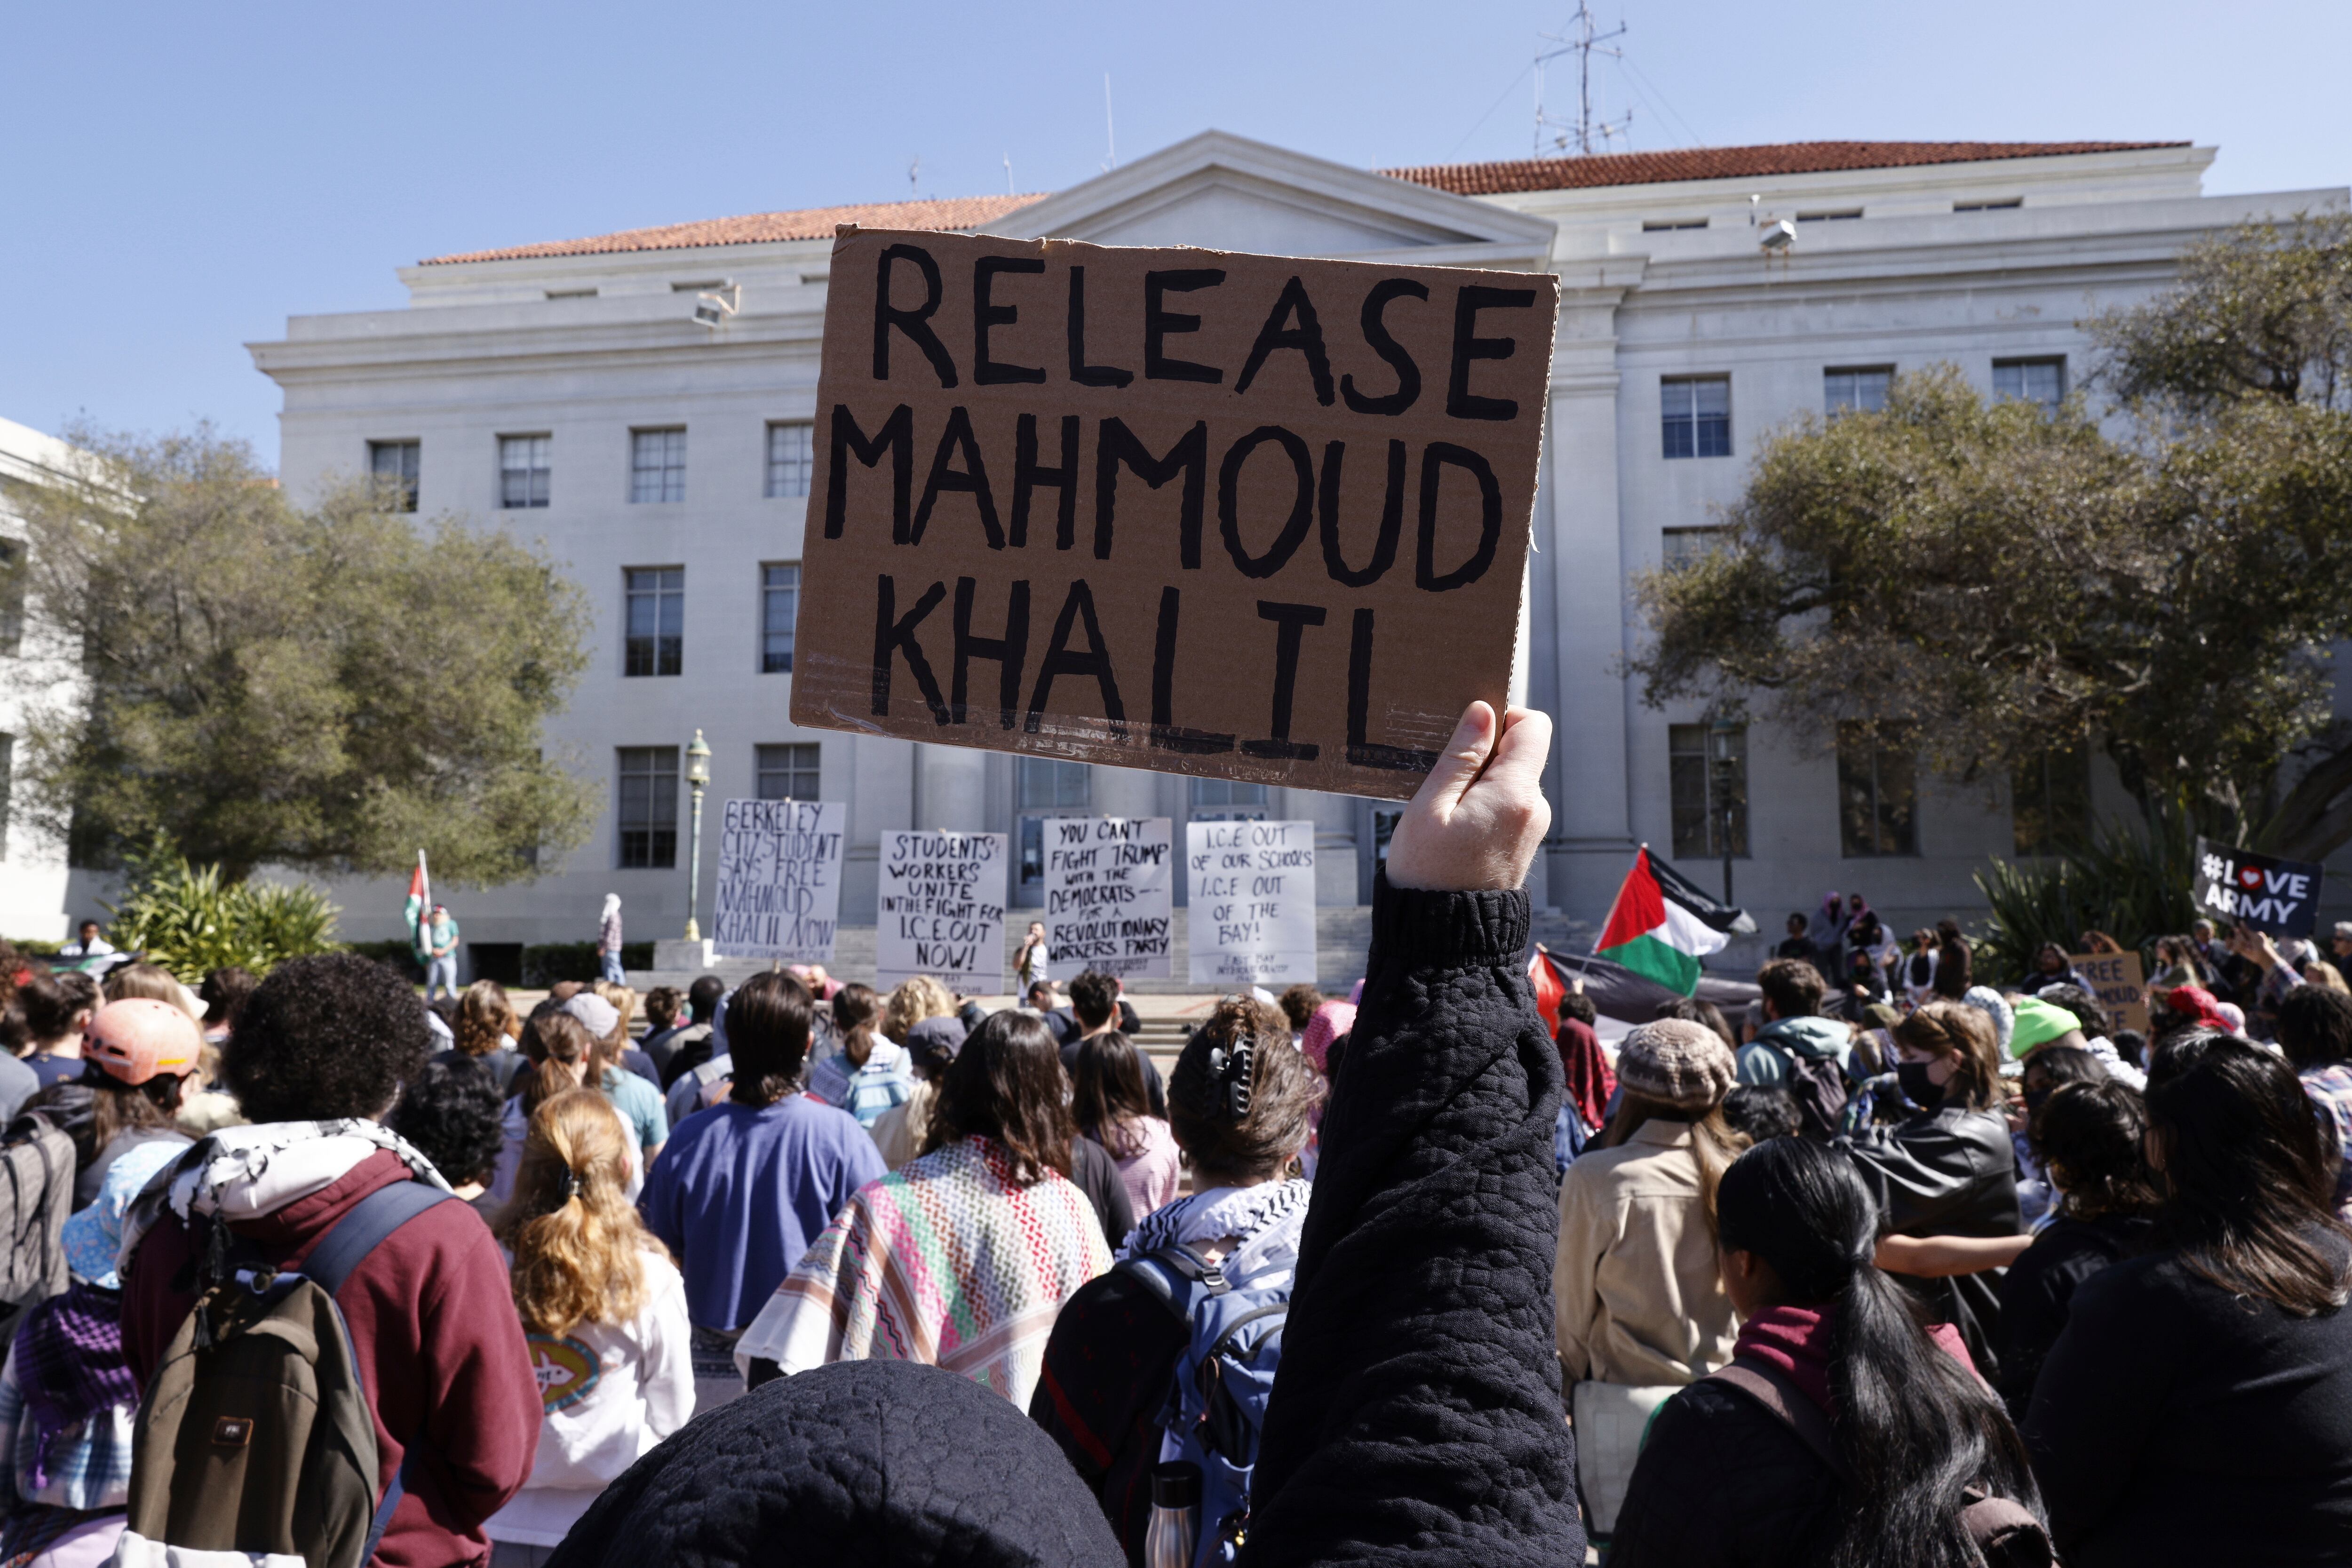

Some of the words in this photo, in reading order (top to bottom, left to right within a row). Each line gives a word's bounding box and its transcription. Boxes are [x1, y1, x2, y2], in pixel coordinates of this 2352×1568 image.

[873, 244, 1536, 421] RELEASE
[824, 404, 1502, 592] MAHMOUD
[871, 574, 1438, 769] KHALIL
[725, 801, 822, 831] BERKELEY
[1060, 824, 1088, 844] YOU
[1252, 824, 1293, 847] OUT
[1051, 845, 1104, 870] FIGHT
[1111, 843, 1169, 866] TRUMP
[1192, 855, 1211, 871] OF
[1222, 854, 1251, 869] OUR
[1259, 850, 1312, 870] SCHOOLS
[719, 856, 762, 884] SAYS
[774, 859, 825, 886] FREE
[888, 862, 980, 883] WORKERS
[1065, 871, 1094, 885] WITH
[1104, 868, 1132, 882] THE
[908, 881, 973, 899] UNITE
[1253, 876, 1285, 897] OUT
[718, 884, 813, 917] MAHMOUD
[925, 898, 975, 918] FIGHT
[980, 904, 1003, 924] FOR
[1079, 906, 1102, 920] FOR
[1112, 907, 1123, 917] A
[1213, 904, 1234, 921] OF
[1248, 902, 1280, 919] THE
[2205, 883, 2298, 924] ARMY
[715, 913, 779, 945] KHALIL
[787, 916, 835, 948] NOW
[1219, 922, 1261, 945] BAY!
[917, 942, 976, 971] NOW!
[1049, 941, 1117, 962] WORKERS
[1126, 938, 1169, 955] PARTY
